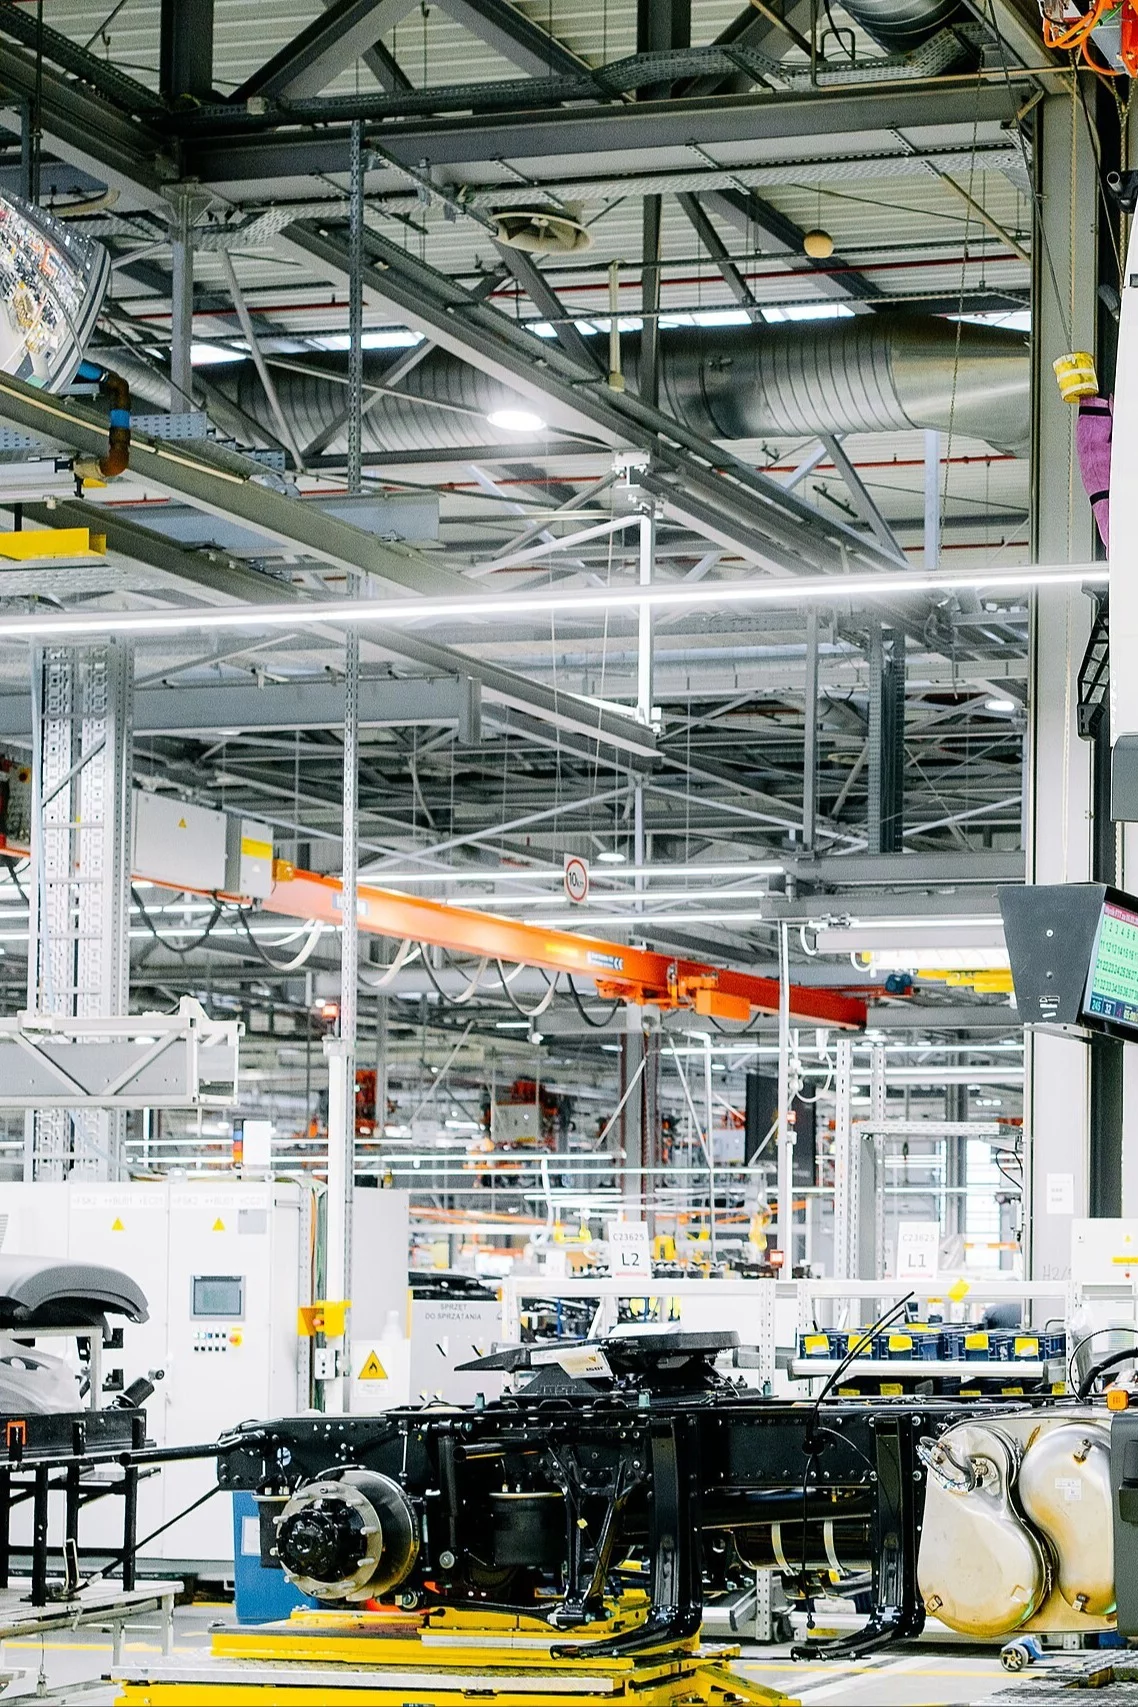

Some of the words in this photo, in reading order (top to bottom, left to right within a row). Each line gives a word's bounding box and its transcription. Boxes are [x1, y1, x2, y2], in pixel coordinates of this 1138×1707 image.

[569, 871, 577, 887] 10
[612, 1233, 645, 1241] C23625
[621, 1252, 640, 1267] L2
[908, 1253, 926, 1268] L1
[425, 1312, 436, 1320] DO
